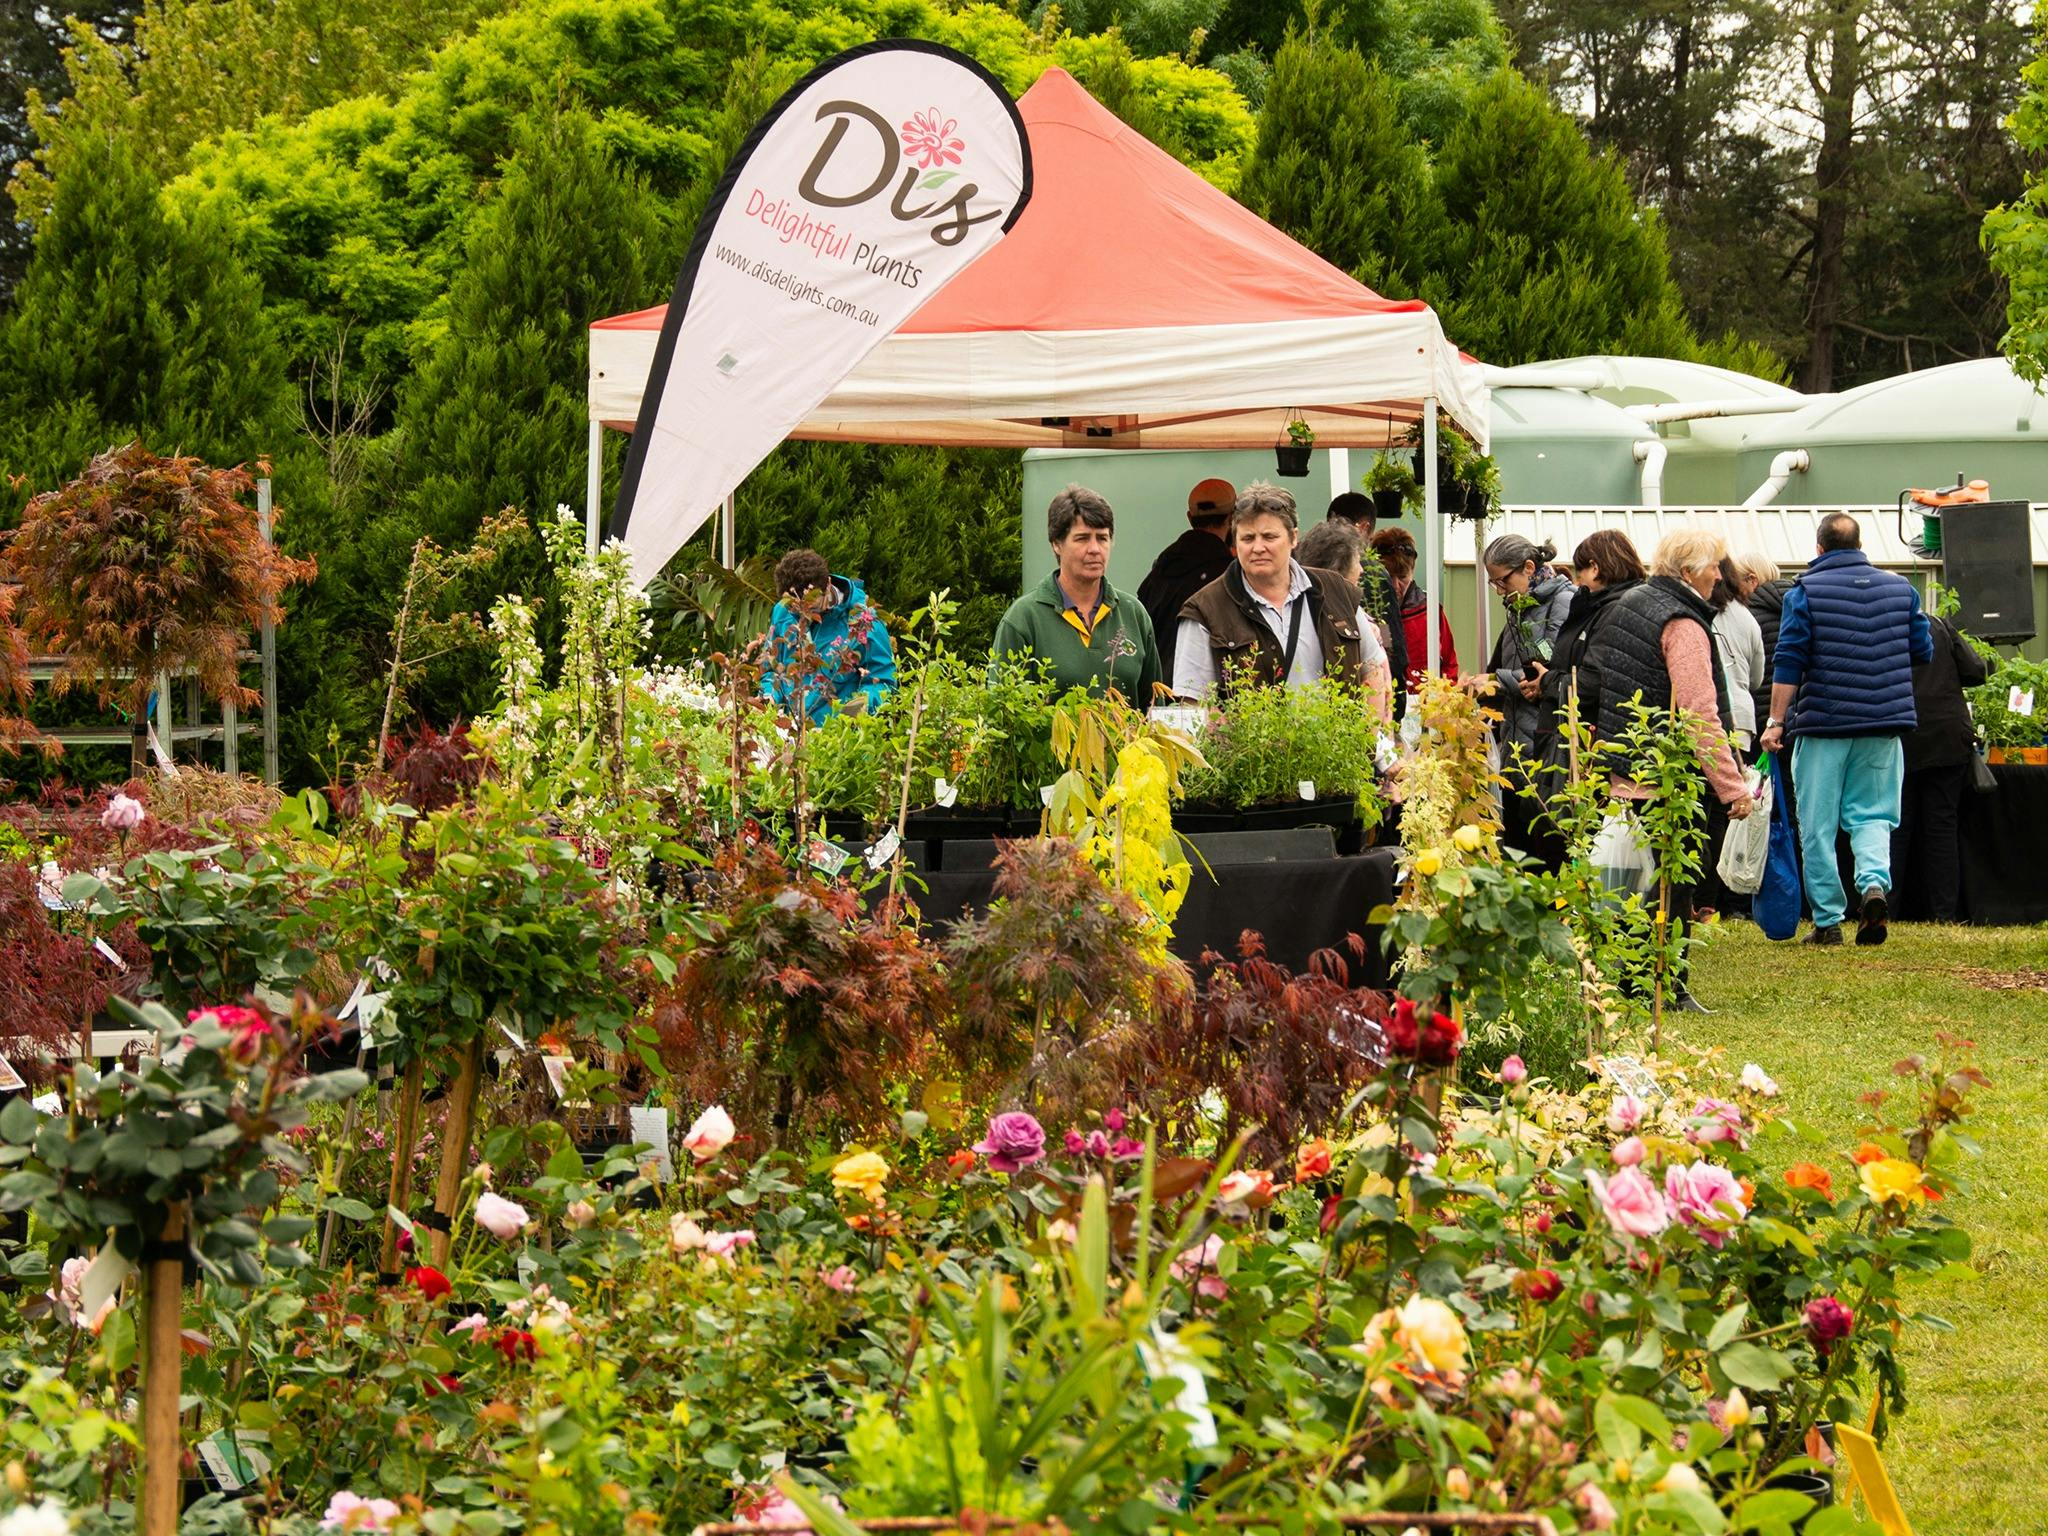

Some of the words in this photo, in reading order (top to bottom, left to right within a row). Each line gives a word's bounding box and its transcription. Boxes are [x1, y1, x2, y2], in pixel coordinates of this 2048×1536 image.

[798, 100, 1003, 247] Dis
[715, 243, 880, 328] www.disdelights.com.au
[744, 188, 852, 260] Delightful
[852, 242, 923, 289] Plants
